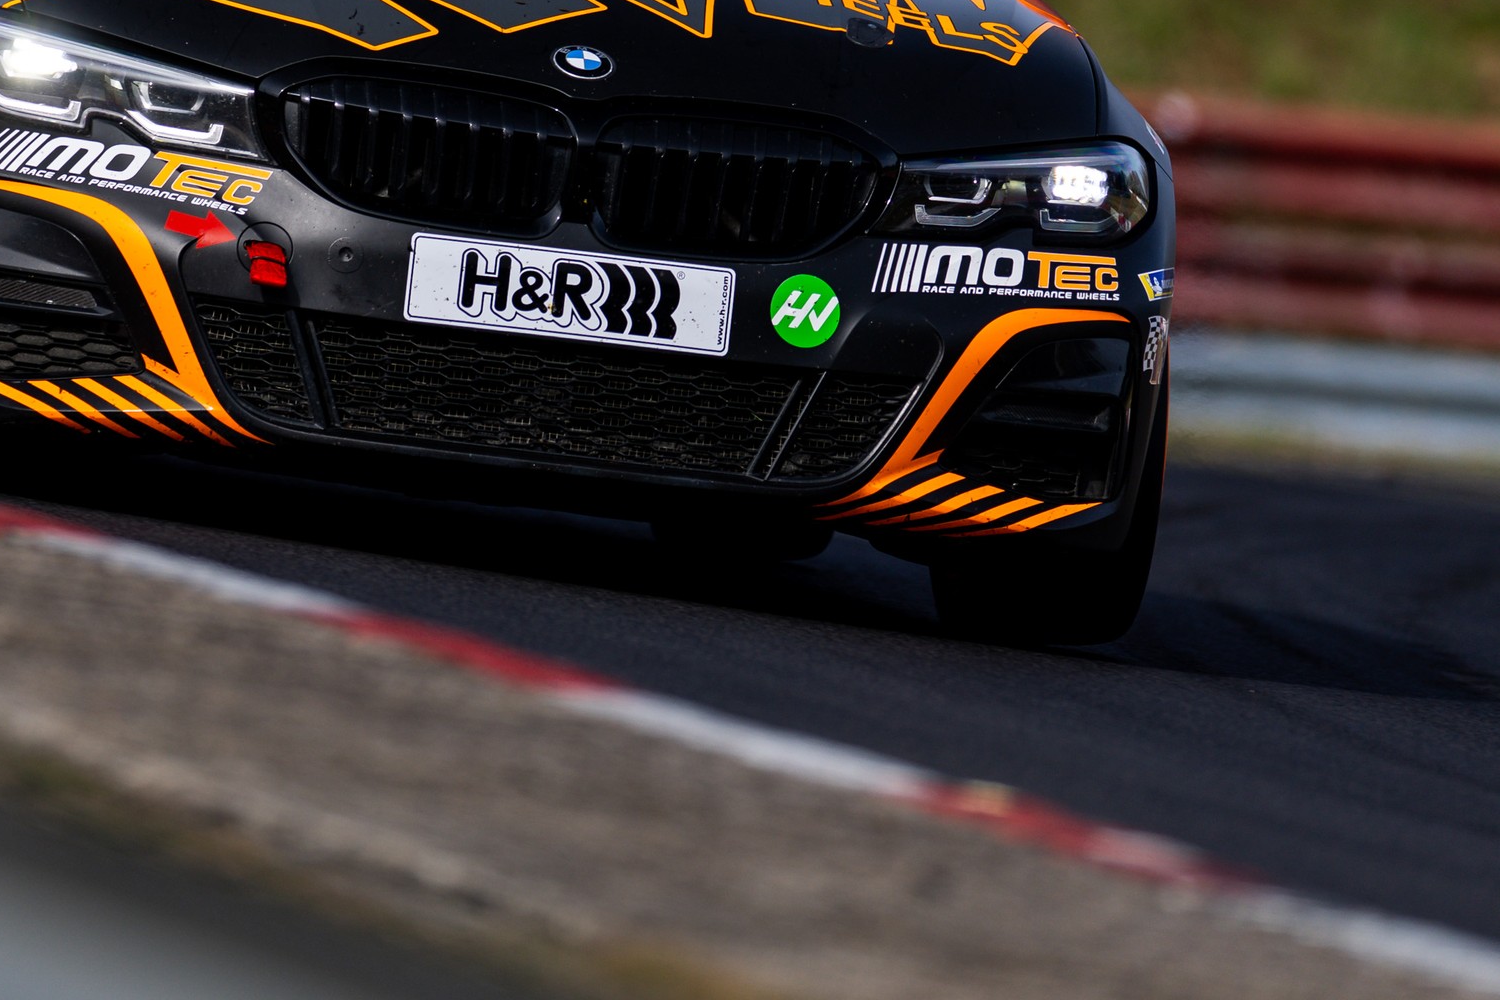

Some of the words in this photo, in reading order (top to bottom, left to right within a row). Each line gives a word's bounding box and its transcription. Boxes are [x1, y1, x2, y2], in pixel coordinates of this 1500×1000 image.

[18, 166, 56, 180] RACE
[57, 172, 85, 184] AND
[88, 178, 187, 203] PERFORMANCE
[190, 196, 249, 216] WHEELS
[457, 247, 606, 332] H&R
[716, 274, 731, 347] www.h-r.com
[921, 284, 956, 295] RACE
[959, 286, 985, 296] AND
[988, 287, 1073, 300] PERFORMANCE
[1076, 292, 1121, 302] WHEELS
